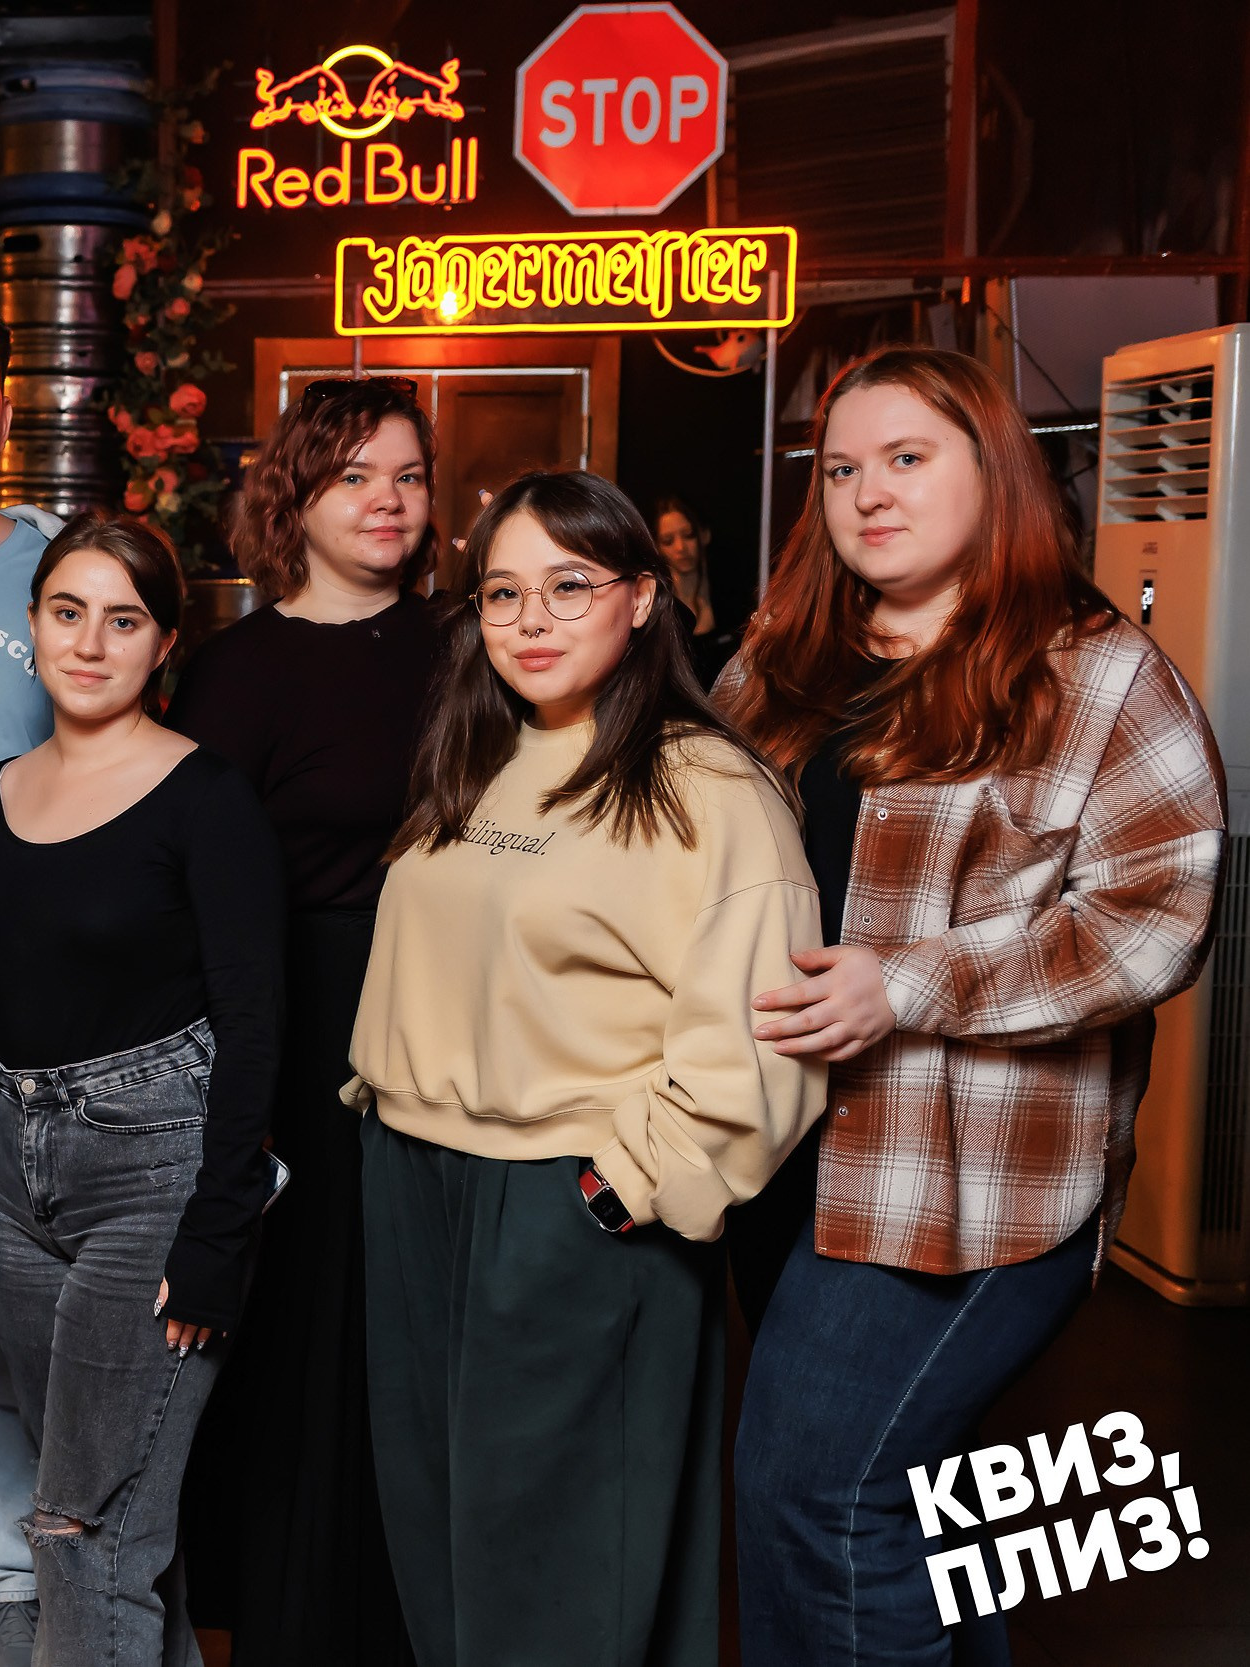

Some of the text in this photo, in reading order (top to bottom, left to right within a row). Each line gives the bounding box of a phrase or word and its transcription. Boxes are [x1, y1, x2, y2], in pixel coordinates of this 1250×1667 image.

[539, 75, 708, 148] STOP
[237, 136, 478, 209] Red Bull
